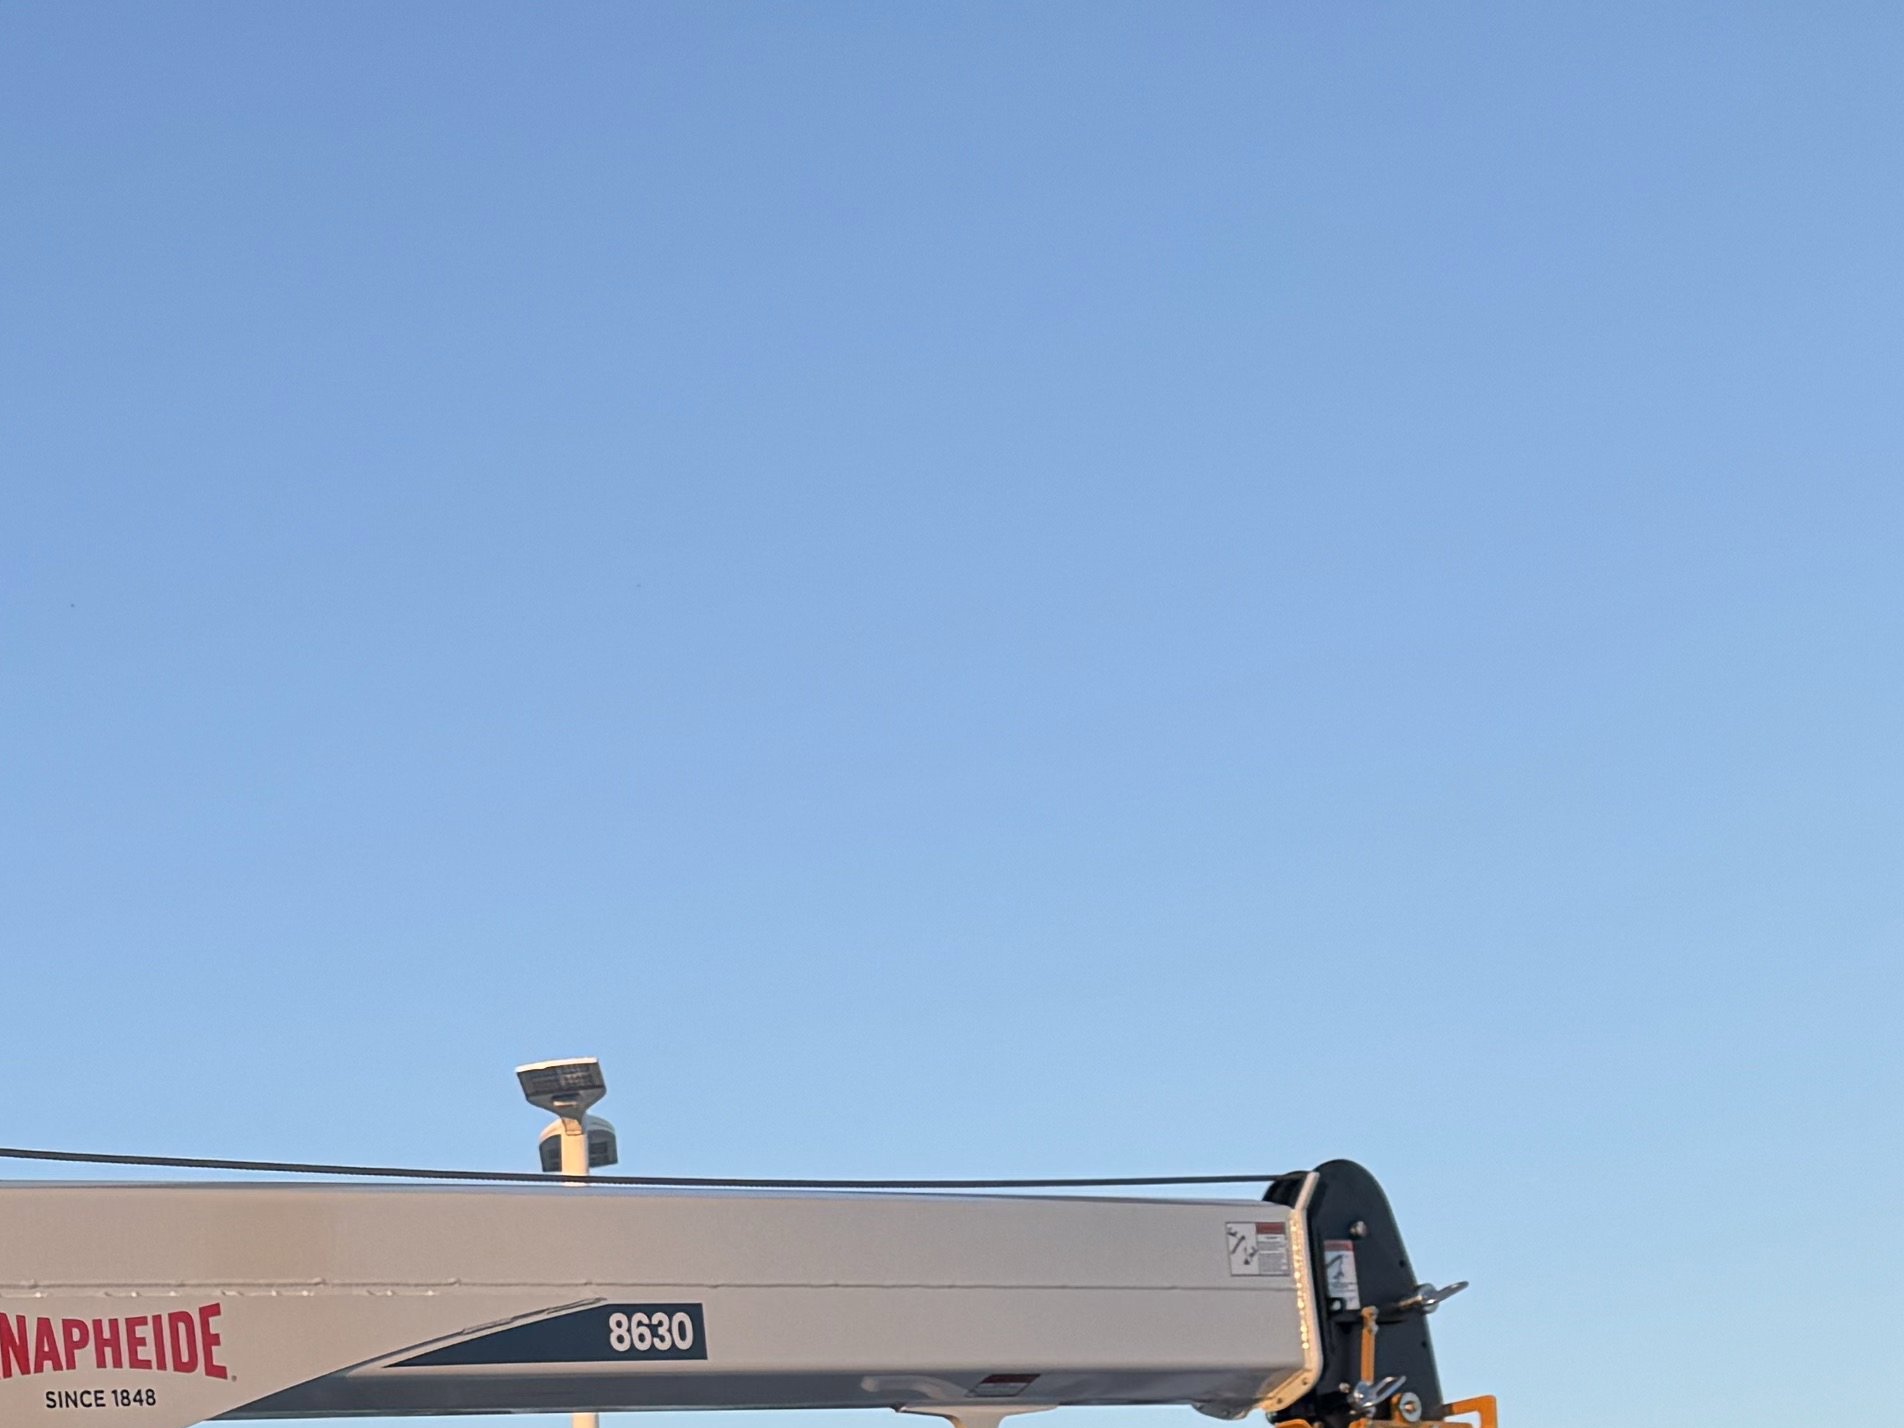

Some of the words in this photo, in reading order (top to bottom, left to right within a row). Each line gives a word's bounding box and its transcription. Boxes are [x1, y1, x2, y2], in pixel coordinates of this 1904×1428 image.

[608, 1311, 694, 1352] 8630
[45, 1389, 106, 1409] SINCE
[111, 1388, 157, 1407] 1848
